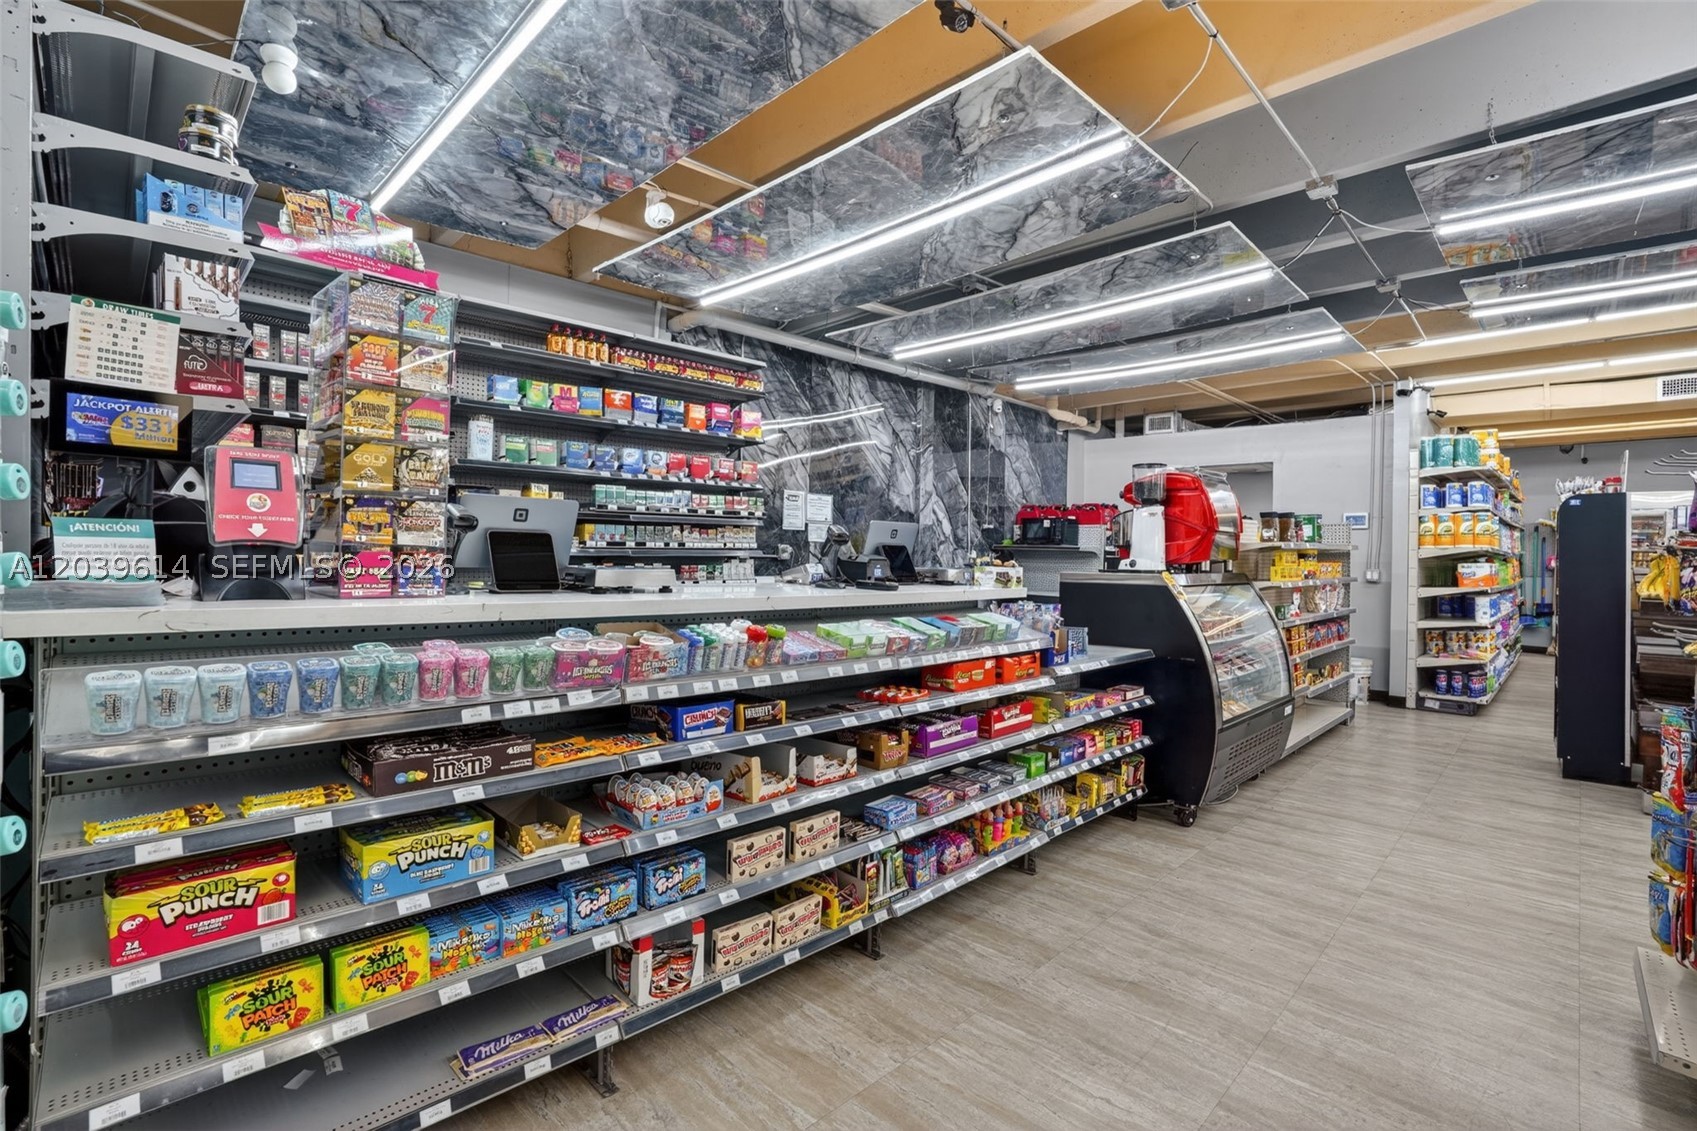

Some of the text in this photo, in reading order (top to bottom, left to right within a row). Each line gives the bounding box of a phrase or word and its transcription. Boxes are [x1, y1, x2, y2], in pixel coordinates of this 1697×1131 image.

[73, 398, 131, 413] JACKPOT
[120, 415, 173, 435] $331
[353, 453, 387, 464] GOLD
[69, 521, 140, 533] ¡ATENCIÓN!
[684, 708, 718, 727] CRUNCH
[691, 760, 722, 771] bueno
[411, 833, 453, 852] SOUR
[396, 841, 468, 874] PUNCH
[180, 877, 238, 902] SOUR
[159, 886, 259, 927] PUNCH
[576, 887, 611, 919] Trolli
[360, 959, 407, 991] PATCH
[362, 951, 404, 976] SOUR
[240, 994, 297, 1031] PATCH
[242, 986, 294, 1014] SOUR
[557, 1003, 599, 1028] Milka
[473, 1032, 524, 1060] Milka
